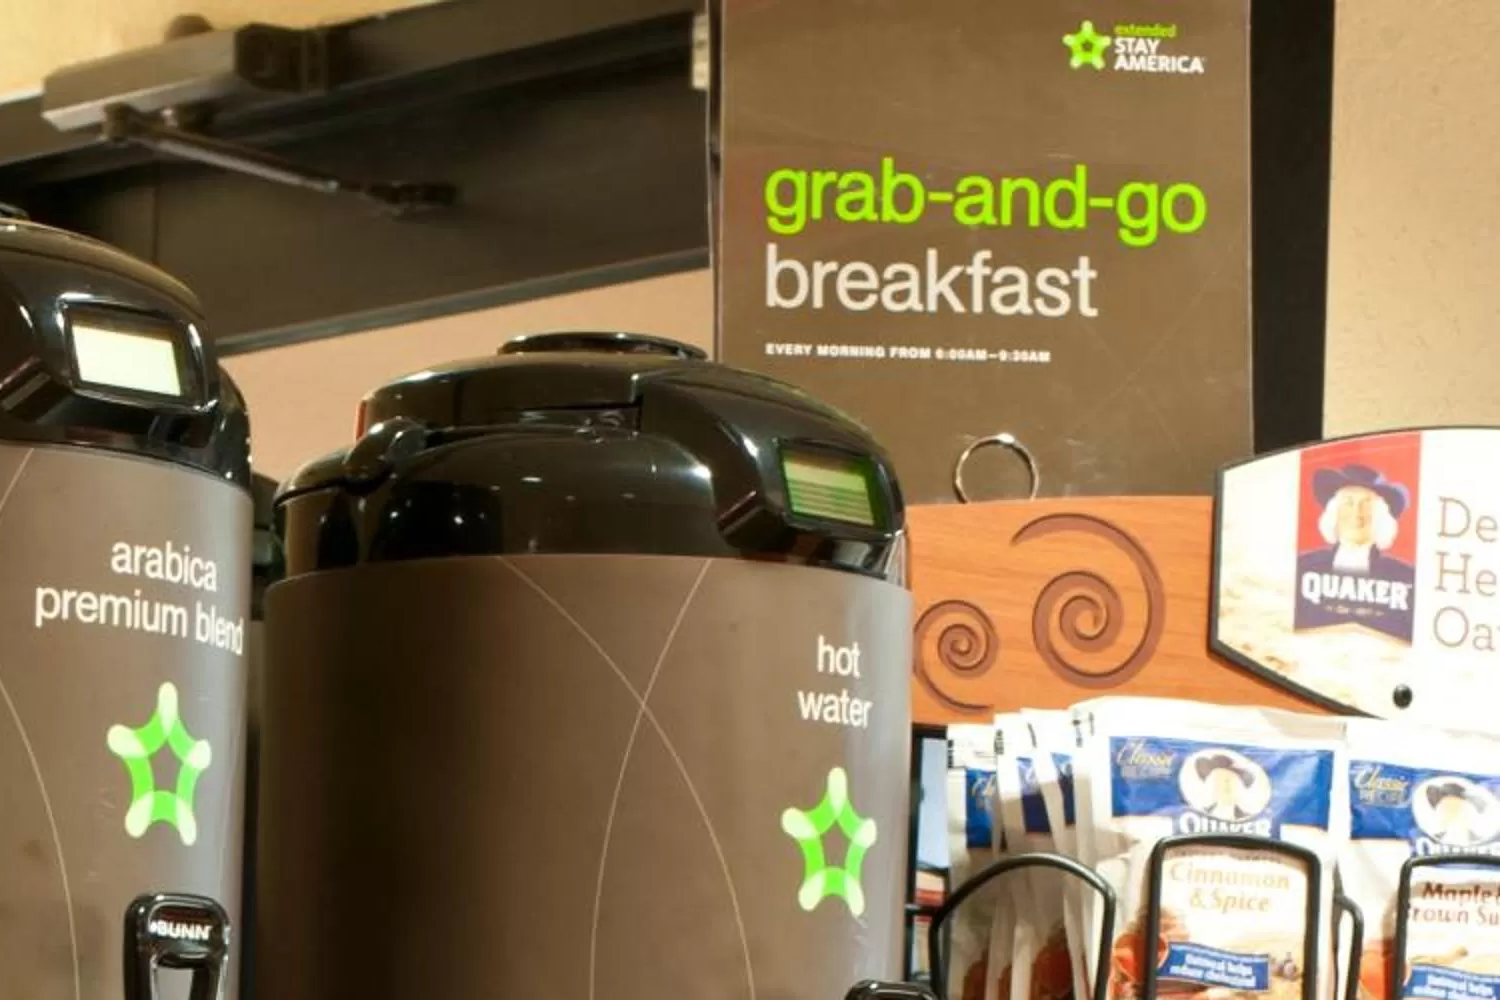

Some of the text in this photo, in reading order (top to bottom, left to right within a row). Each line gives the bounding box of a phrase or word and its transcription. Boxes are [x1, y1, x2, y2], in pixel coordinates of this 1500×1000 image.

[1114, 38, 1161, 54] STAY
[1114, 55, 1205, 74] AMERICA
[764, 157, 1208, 247] grab-and-go
[765, 243, 1099, 318] breakfast
[765, 342, 812, 356] EVERY
[816, 344, 886, 358] MORNING
[889, 346, 932, 360] FROM
[1436, 496, 1499, 542] De
[110, 541, 218, 593] arabica
[1434, 551, 1498, 597] He
[1301, 571, 1409, 611] QUAKER
[35, 586, 245, 656] premium blend
[1433, 606, 1500, 652] Oa
[817, 634, 861, 679] hot
[797, 688, 874, 730] water
[1169, 861, 1290, 889] Cinnamon
[1422, 881, 1493, 906] Maple
[1189, 887, 1272, 914] & Spice
[1405, 905, 1470, 925] rown
[156, 919, 210, 940] BUNN
